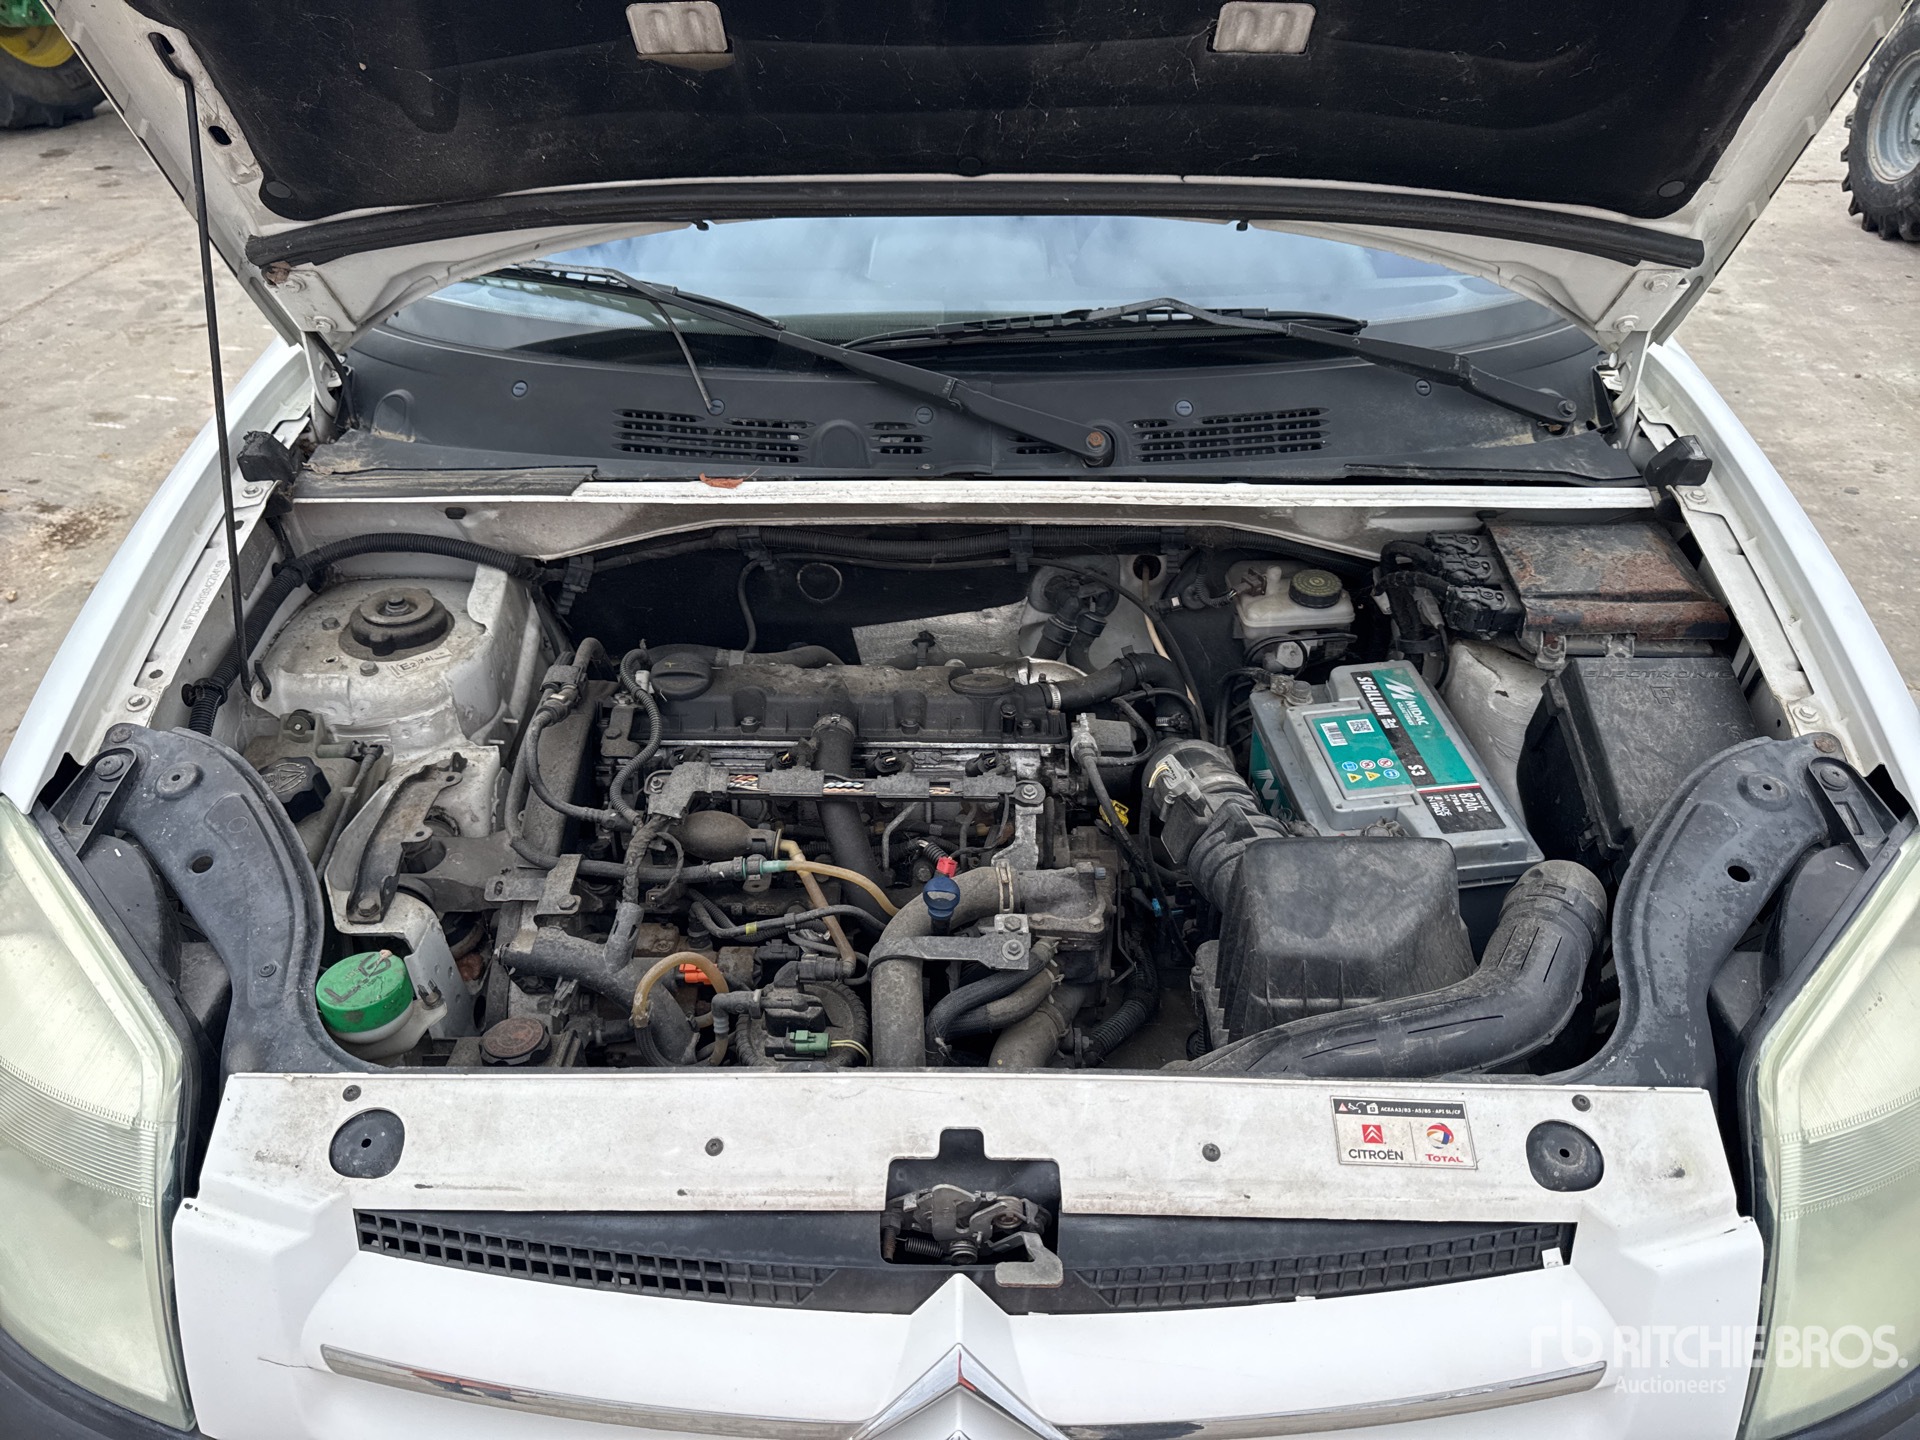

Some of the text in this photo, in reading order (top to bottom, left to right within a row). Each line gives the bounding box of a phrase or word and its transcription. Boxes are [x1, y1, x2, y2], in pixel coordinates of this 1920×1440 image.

[1583, 670, 1735, 679] ELECTRONIC
[1356, 676, 1393, 716] SIGILLUM
[1405, 700, 1429, 726] MIDAC
[1407, 764, 1427, 776] S3
[1430, 802, 1445, 817] ITALY
[1458, 792, 1482, 812] 82Ah
[1348, 1149, 1404, 1161] CITROËN
